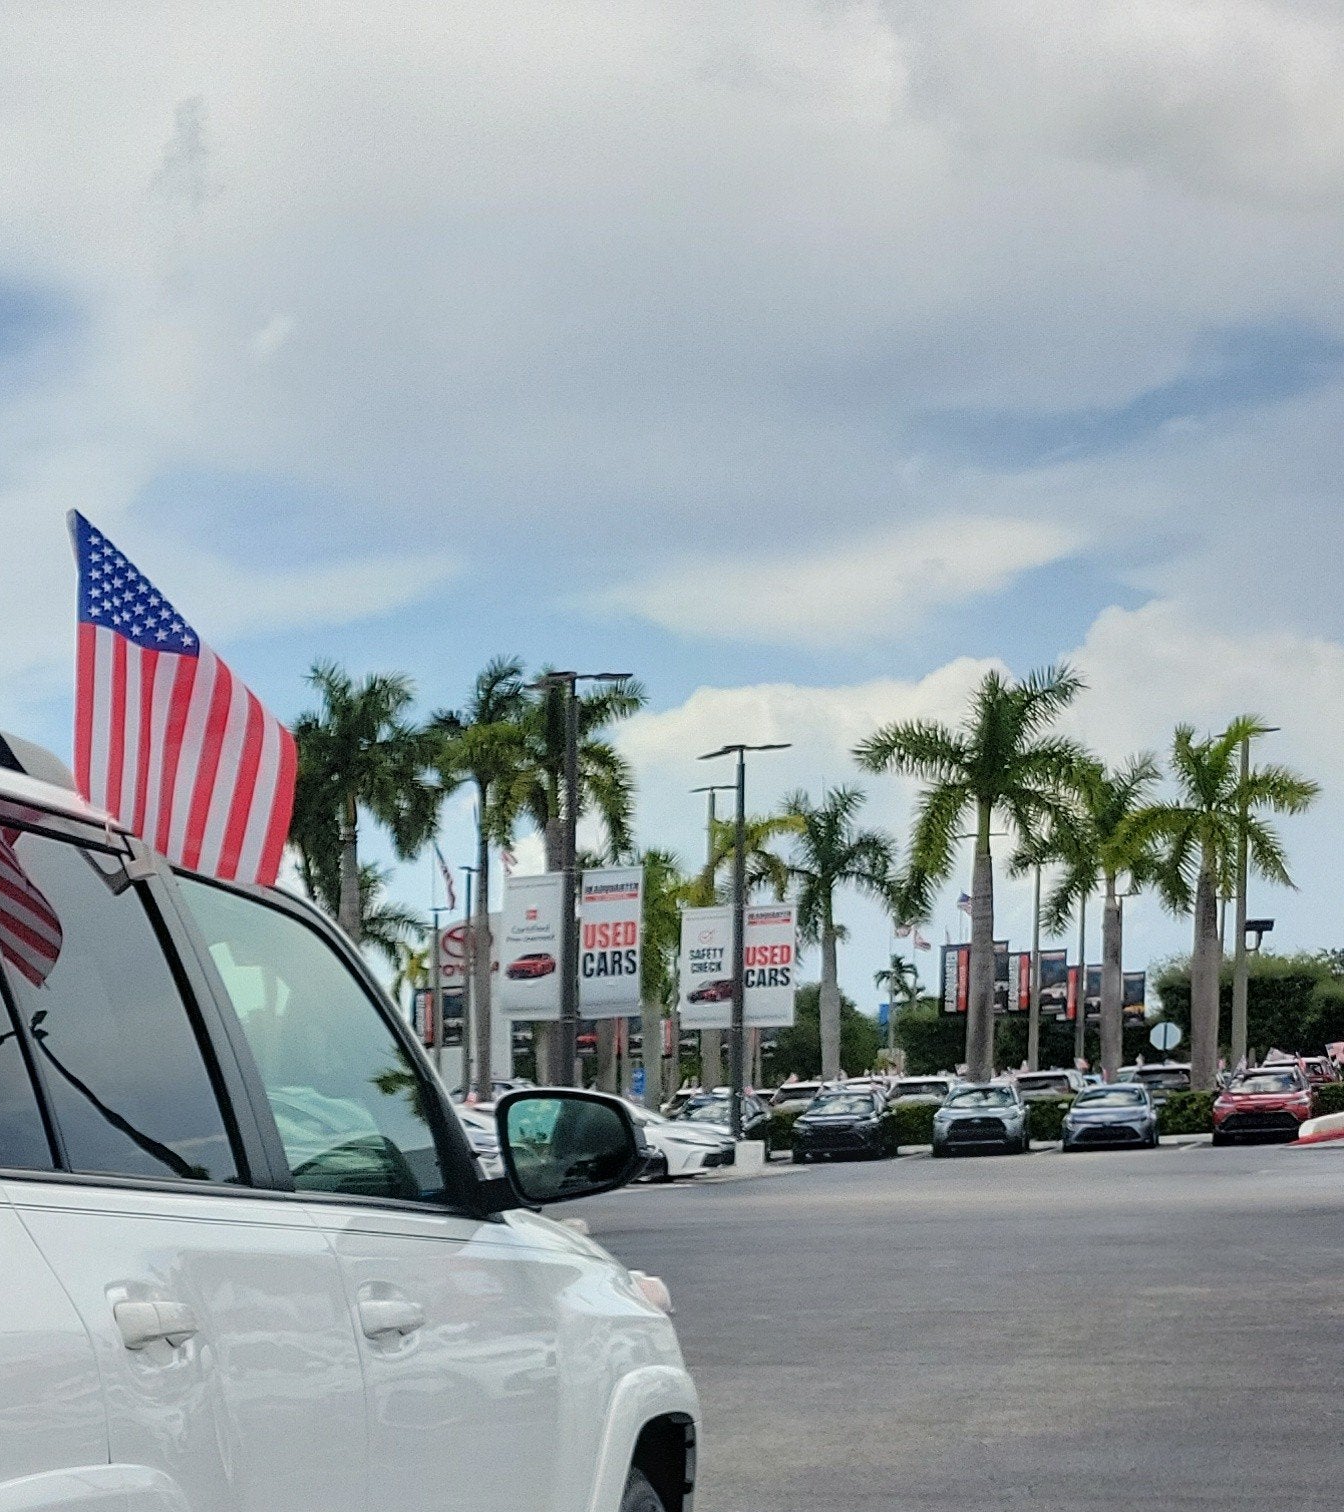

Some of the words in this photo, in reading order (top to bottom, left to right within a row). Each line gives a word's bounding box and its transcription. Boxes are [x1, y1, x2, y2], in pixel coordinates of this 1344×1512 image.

[583, 921, 637, 950] USED
[583, 949, 637, 978] CARS
[689, 947, 724, 960] SAFETY
[745, 944, 791, 967] USED
[691, 961, 722, 974] CHECK
[744, 967, 791, 989] CARS
